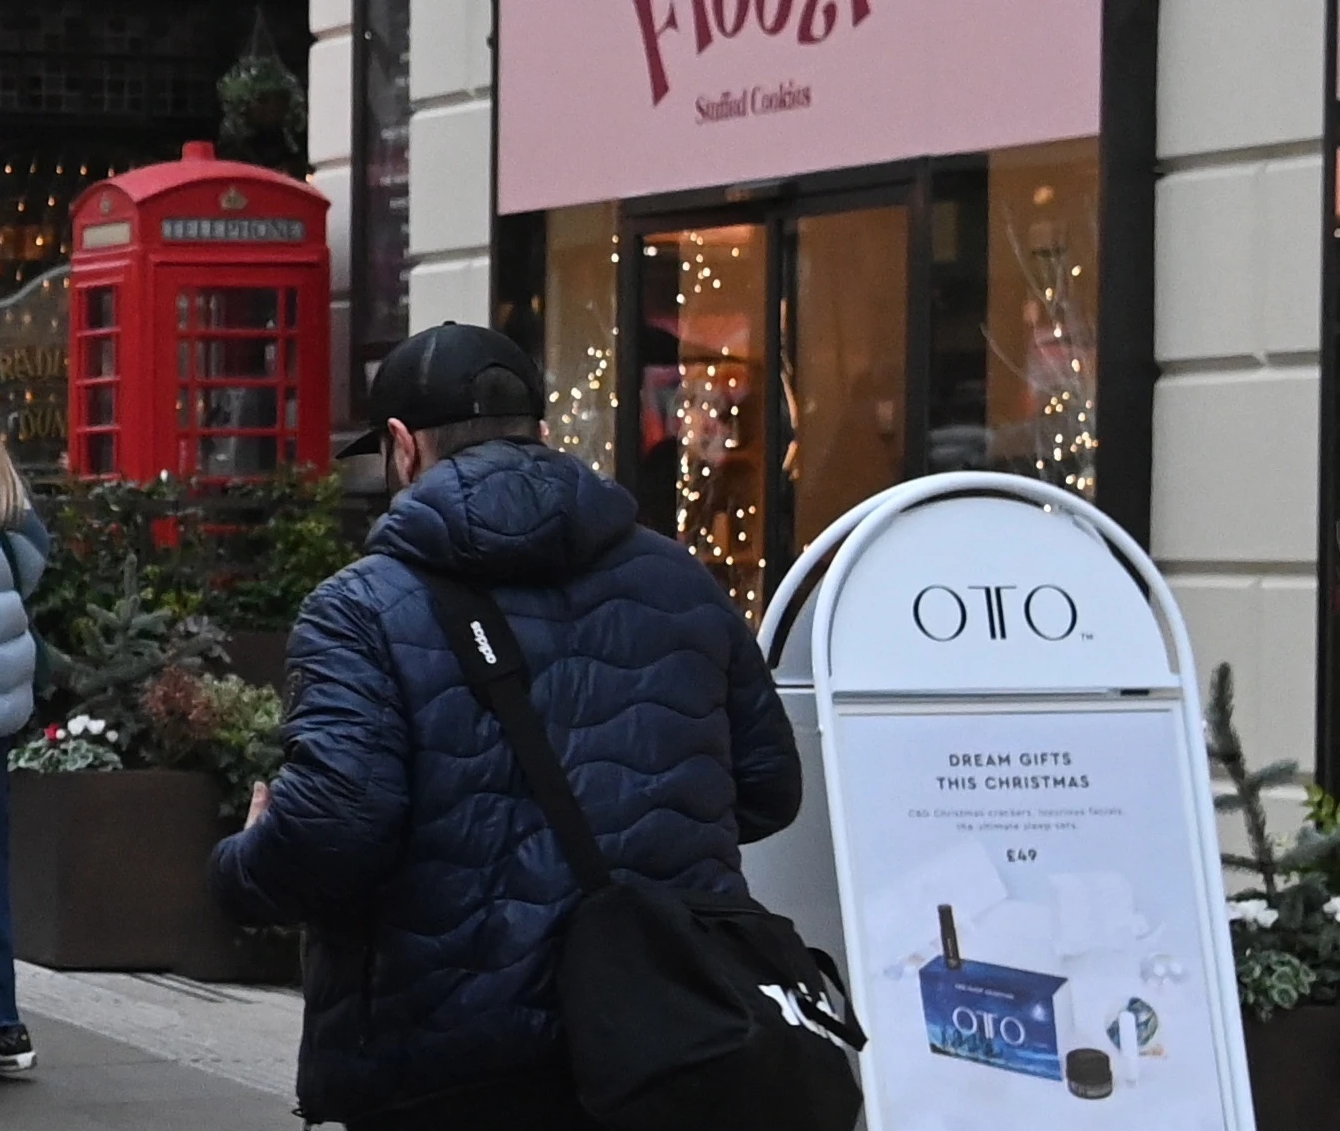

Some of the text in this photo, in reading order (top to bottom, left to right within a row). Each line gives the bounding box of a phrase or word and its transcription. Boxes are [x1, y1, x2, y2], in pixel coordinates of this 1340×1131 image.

[695, 79, 812, 124] Stuffed Cookies
[162, 219, 304, 241] TELEPHONE
[913, 584, 1078, 642] OTO
[949, 751, 1072, 768] DREAM GIFTS
[936, 774, 1090, 790] THIS CHRISTMAS
[1006, 848, 1038, 863] £49
[952, 1006, 1025, 1045] OTO
